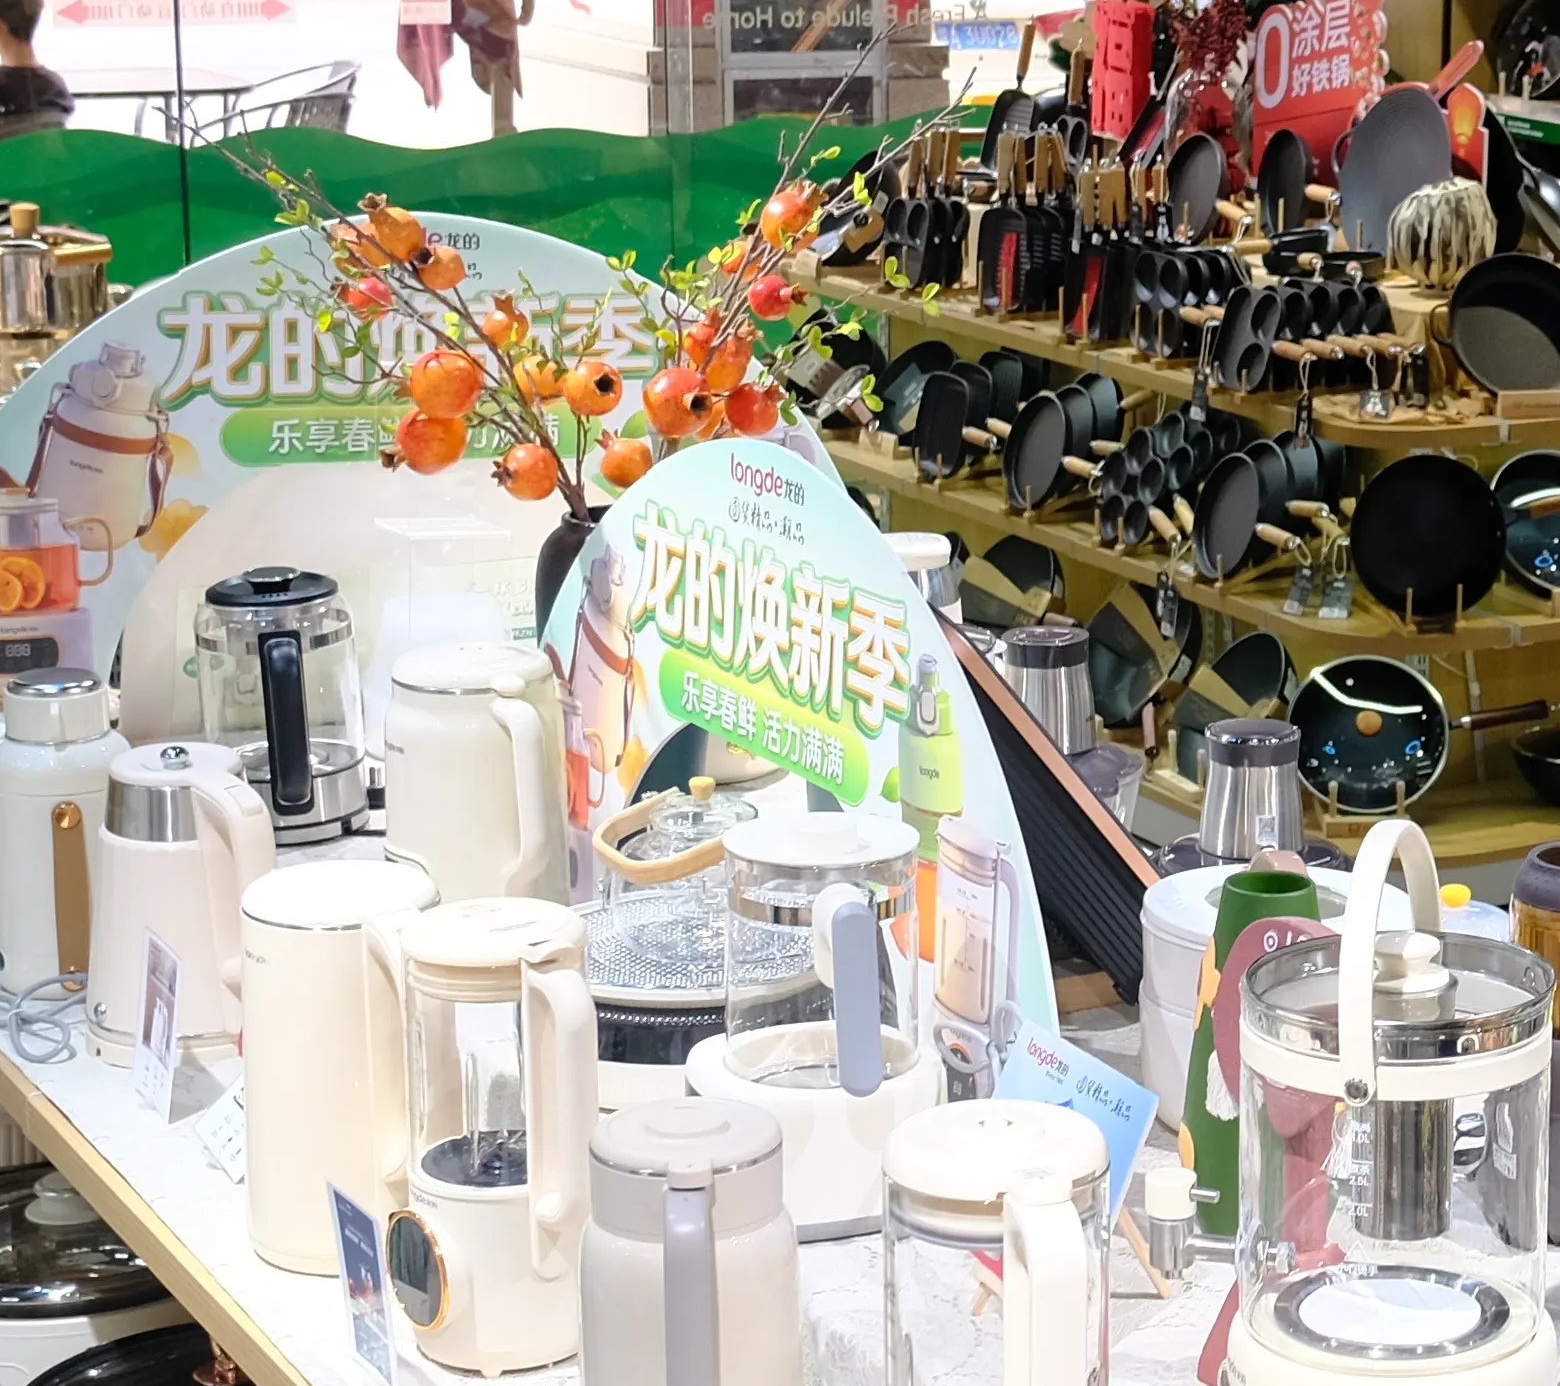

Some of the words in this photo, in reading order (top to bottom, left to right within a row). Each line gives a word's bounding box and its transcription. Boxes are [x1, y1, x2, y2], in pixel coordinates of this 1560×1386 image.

[1291, 53, 1351, 98] 好铁锅
[730, 453, 806, 507] longde龙的
[630, 503, 912, 731] 龙的焕新季
[681, 670, 758, 743] 乐享春鲜
[761, 705, 844, 787] 活力满满
